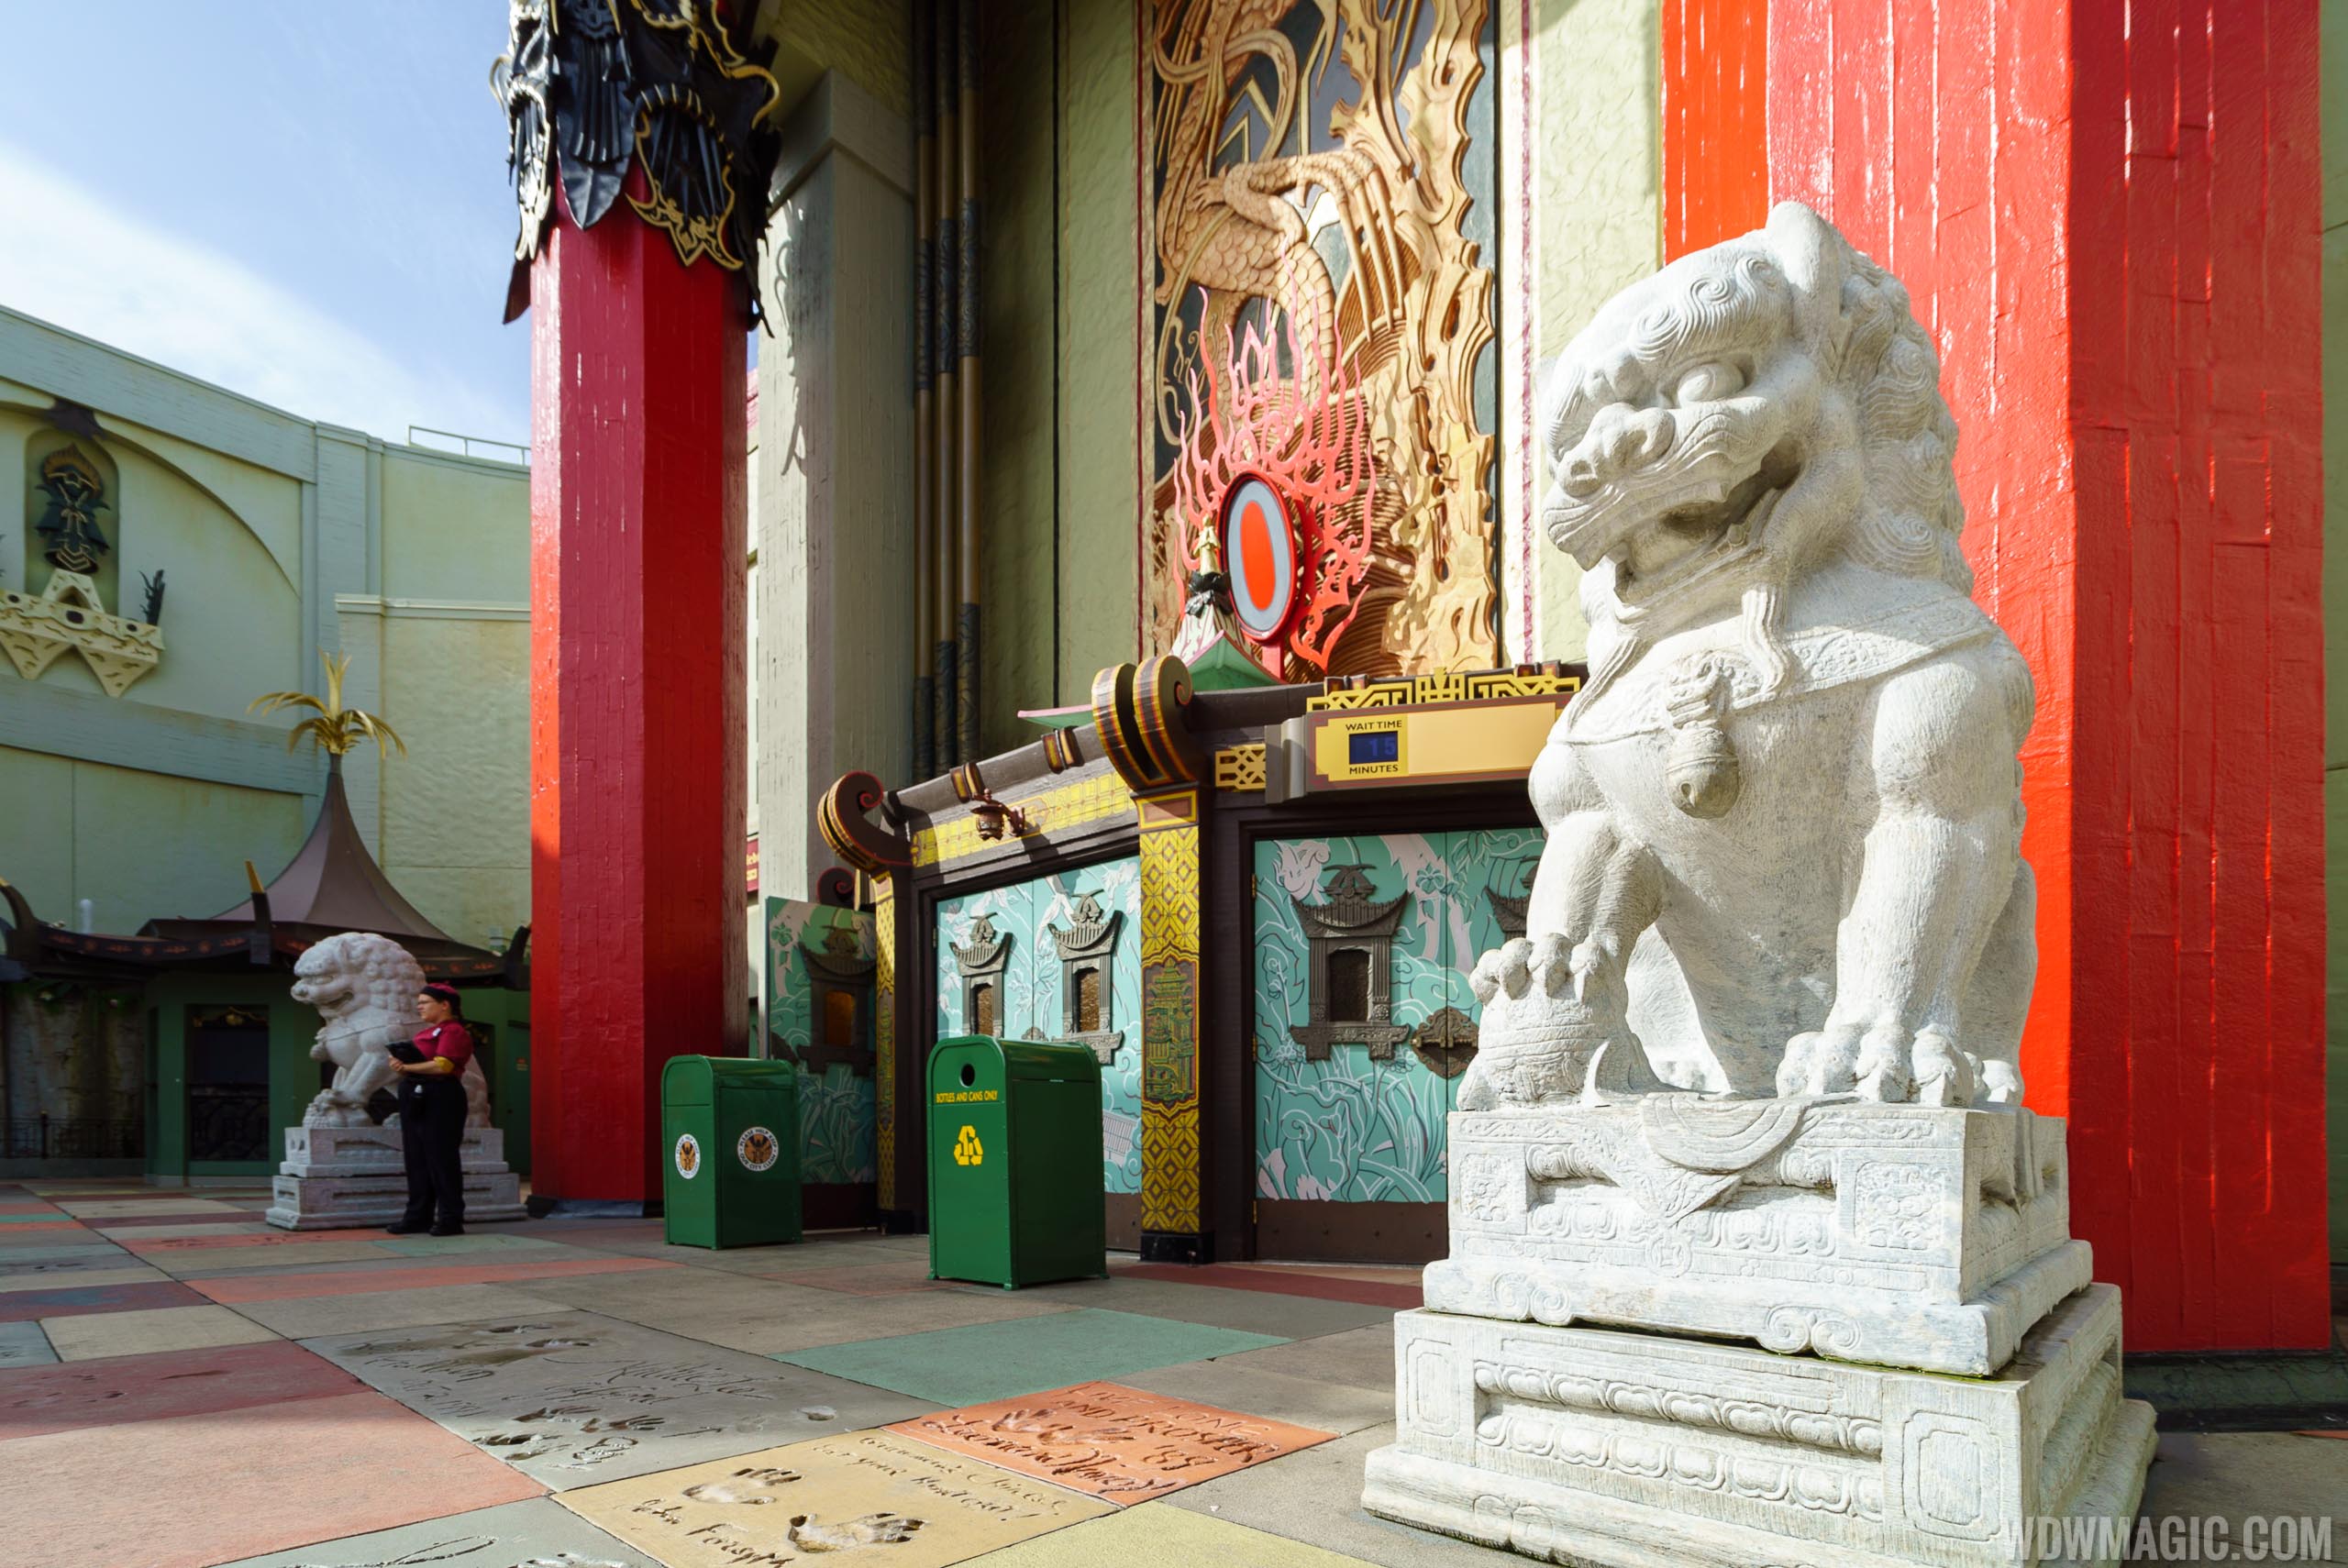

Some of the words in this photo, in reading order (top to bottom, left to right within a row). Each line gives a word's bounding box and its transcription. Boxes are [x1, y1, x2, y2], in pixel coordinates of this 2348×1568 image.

[1346, 722, 1375, 731] WAIT
[1376, 720, 1402, 729] TIME
[1368, 736, 1396, 756] 15
[1349, 764, 1399, 775] MINUTES
[936, 1092, 955, 1103] BOTTLES
[956, 1091, 968, 1102] AND
[969, 1090, 983, 1101] CANS
[983, 1089, 998, 1101] ONLY
[1056, 1399, 1117, 1419] AND
[1108, 1414, 1280, 1464] PROSPER
